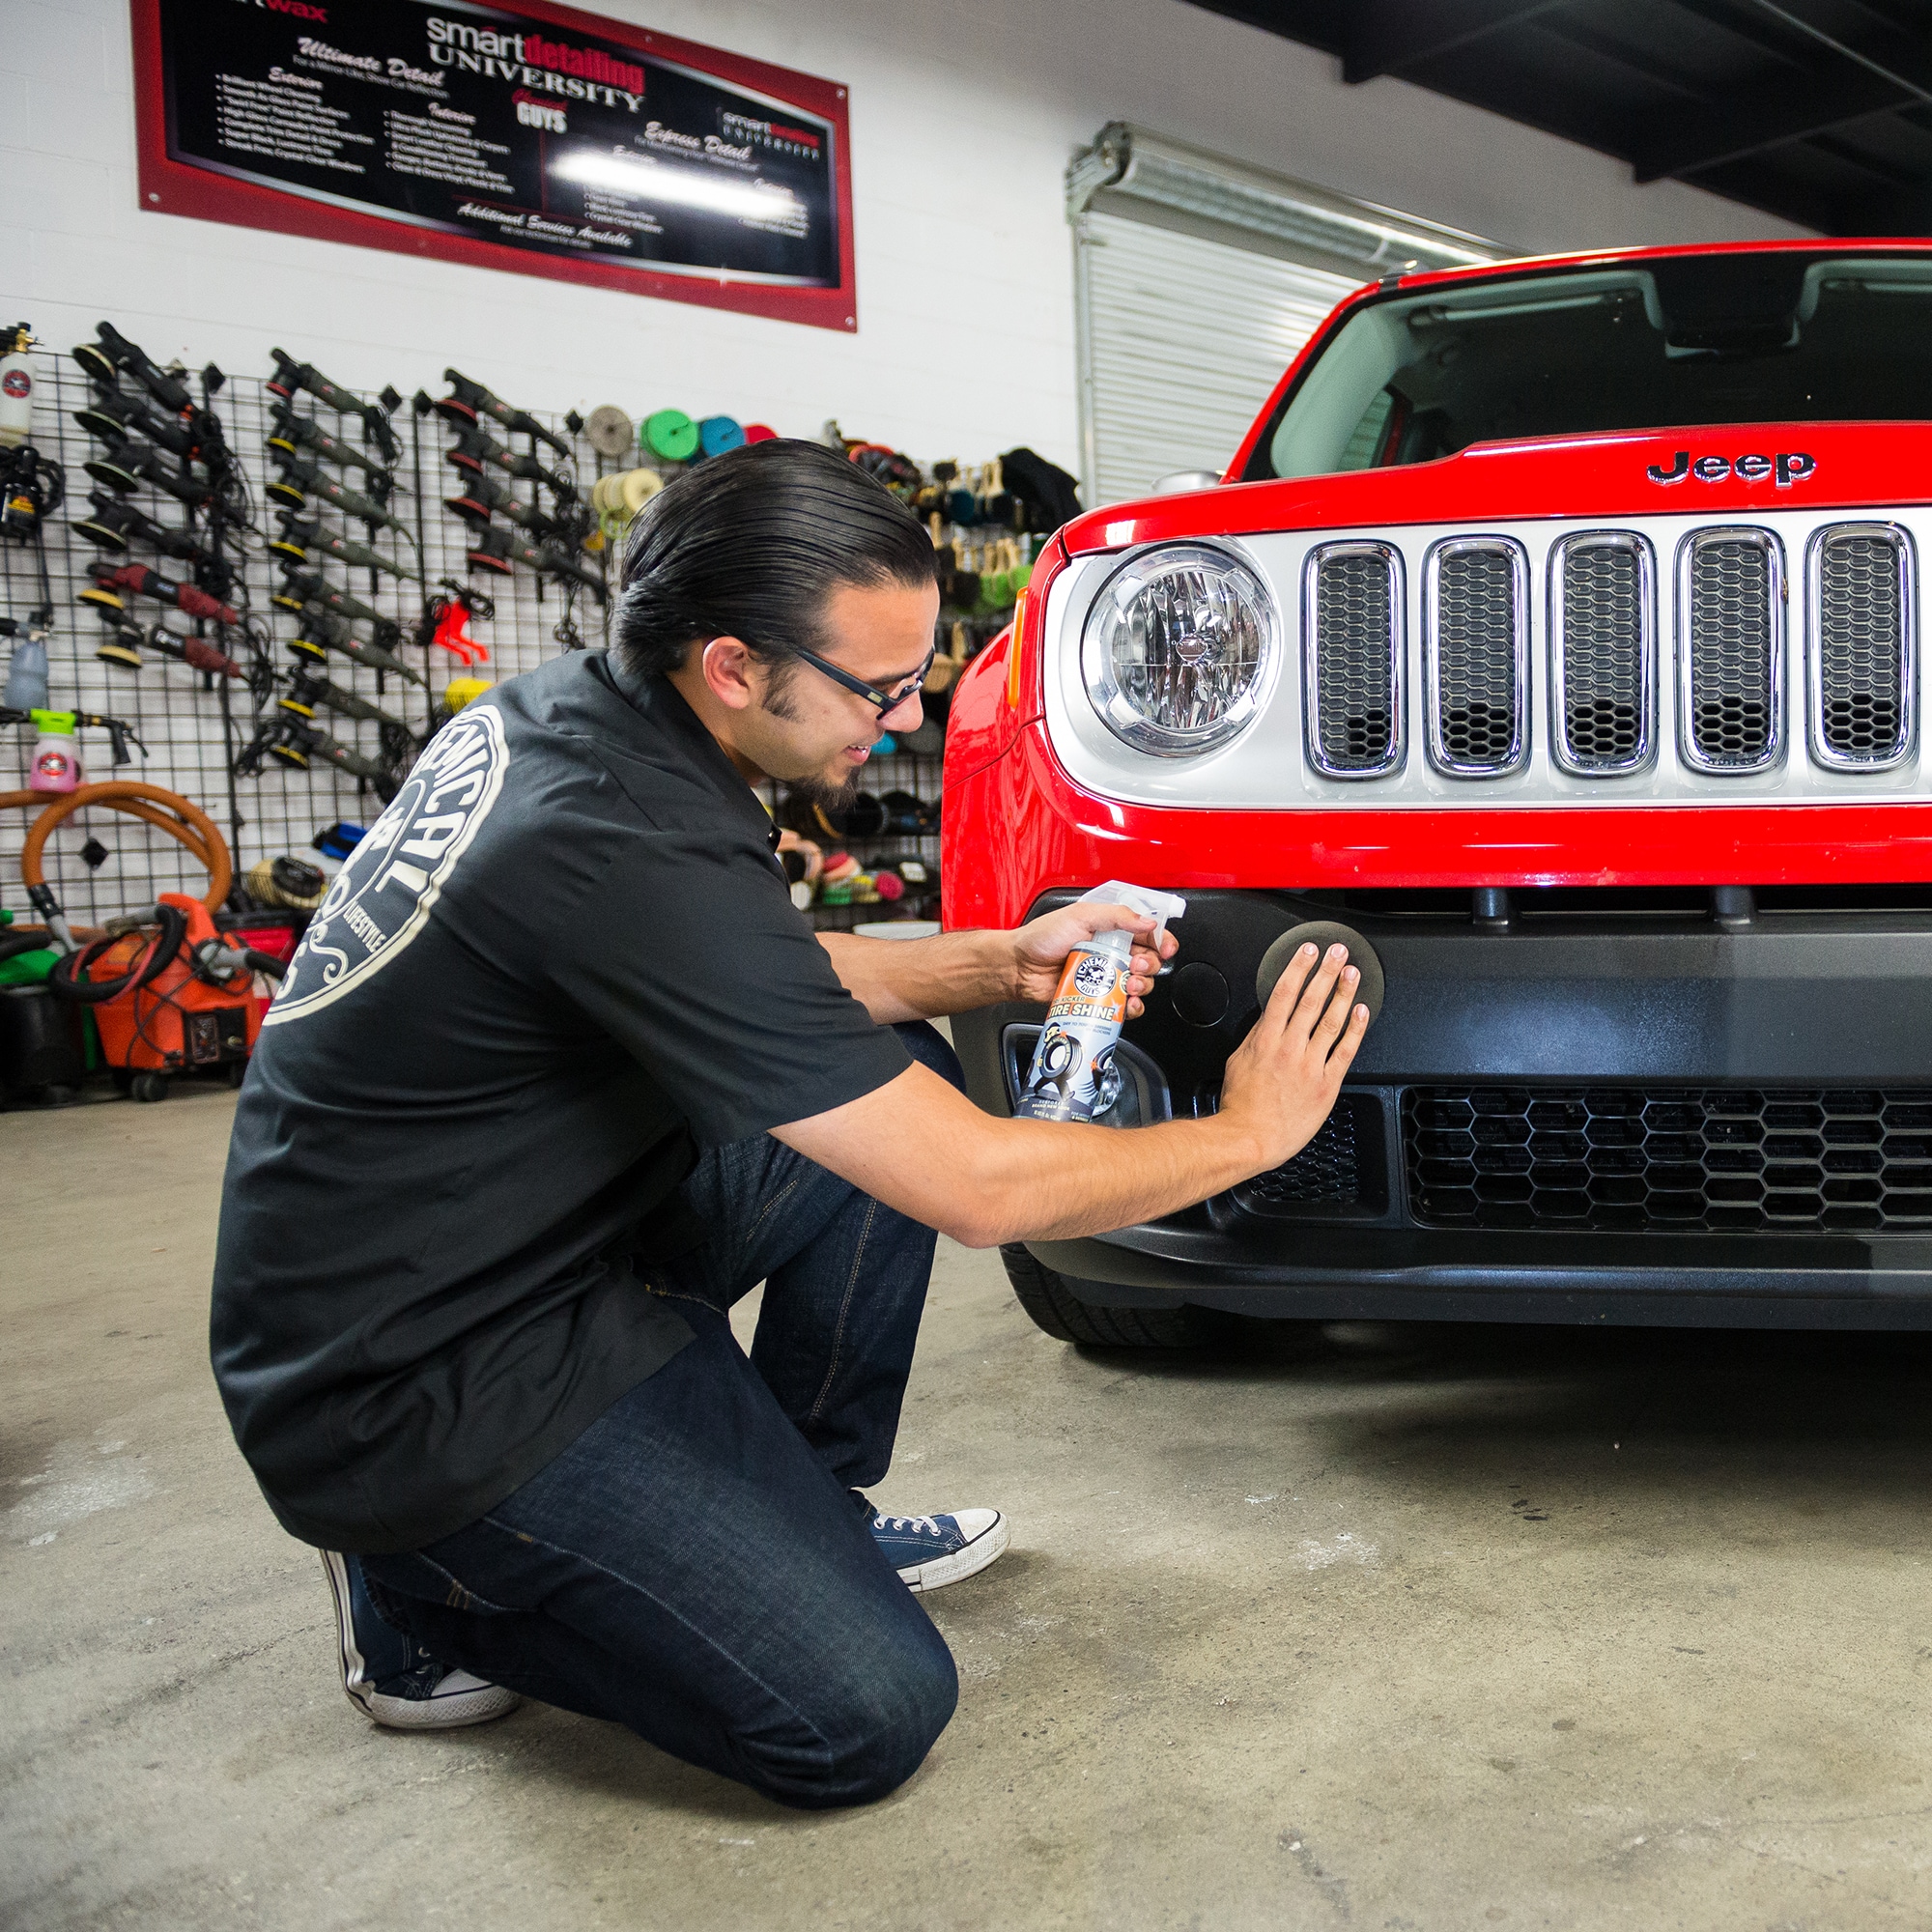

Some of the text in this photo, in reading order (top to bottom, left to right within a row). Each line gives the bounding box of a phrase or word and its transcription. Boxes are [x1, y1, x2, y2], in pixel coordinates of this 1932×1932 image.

[298, 36, 446, 88] Ultimate Detail
[427, 42, 646, 114] UNIVERSITY
[516, 101, 568, 134] GUYS
[644, 120, 701, 150] Express
[704, 134, 753, 161] Detail
[457, 202, 635, 248] Additional Services Available
[1646, 451, 1818, 488] Jeep
[343, 901, 388, 953] LIFESTYLE
[1080, 983, 1101, 995] GUYS
[1049, 1003, 1116, 1022] TIRE SHINE
